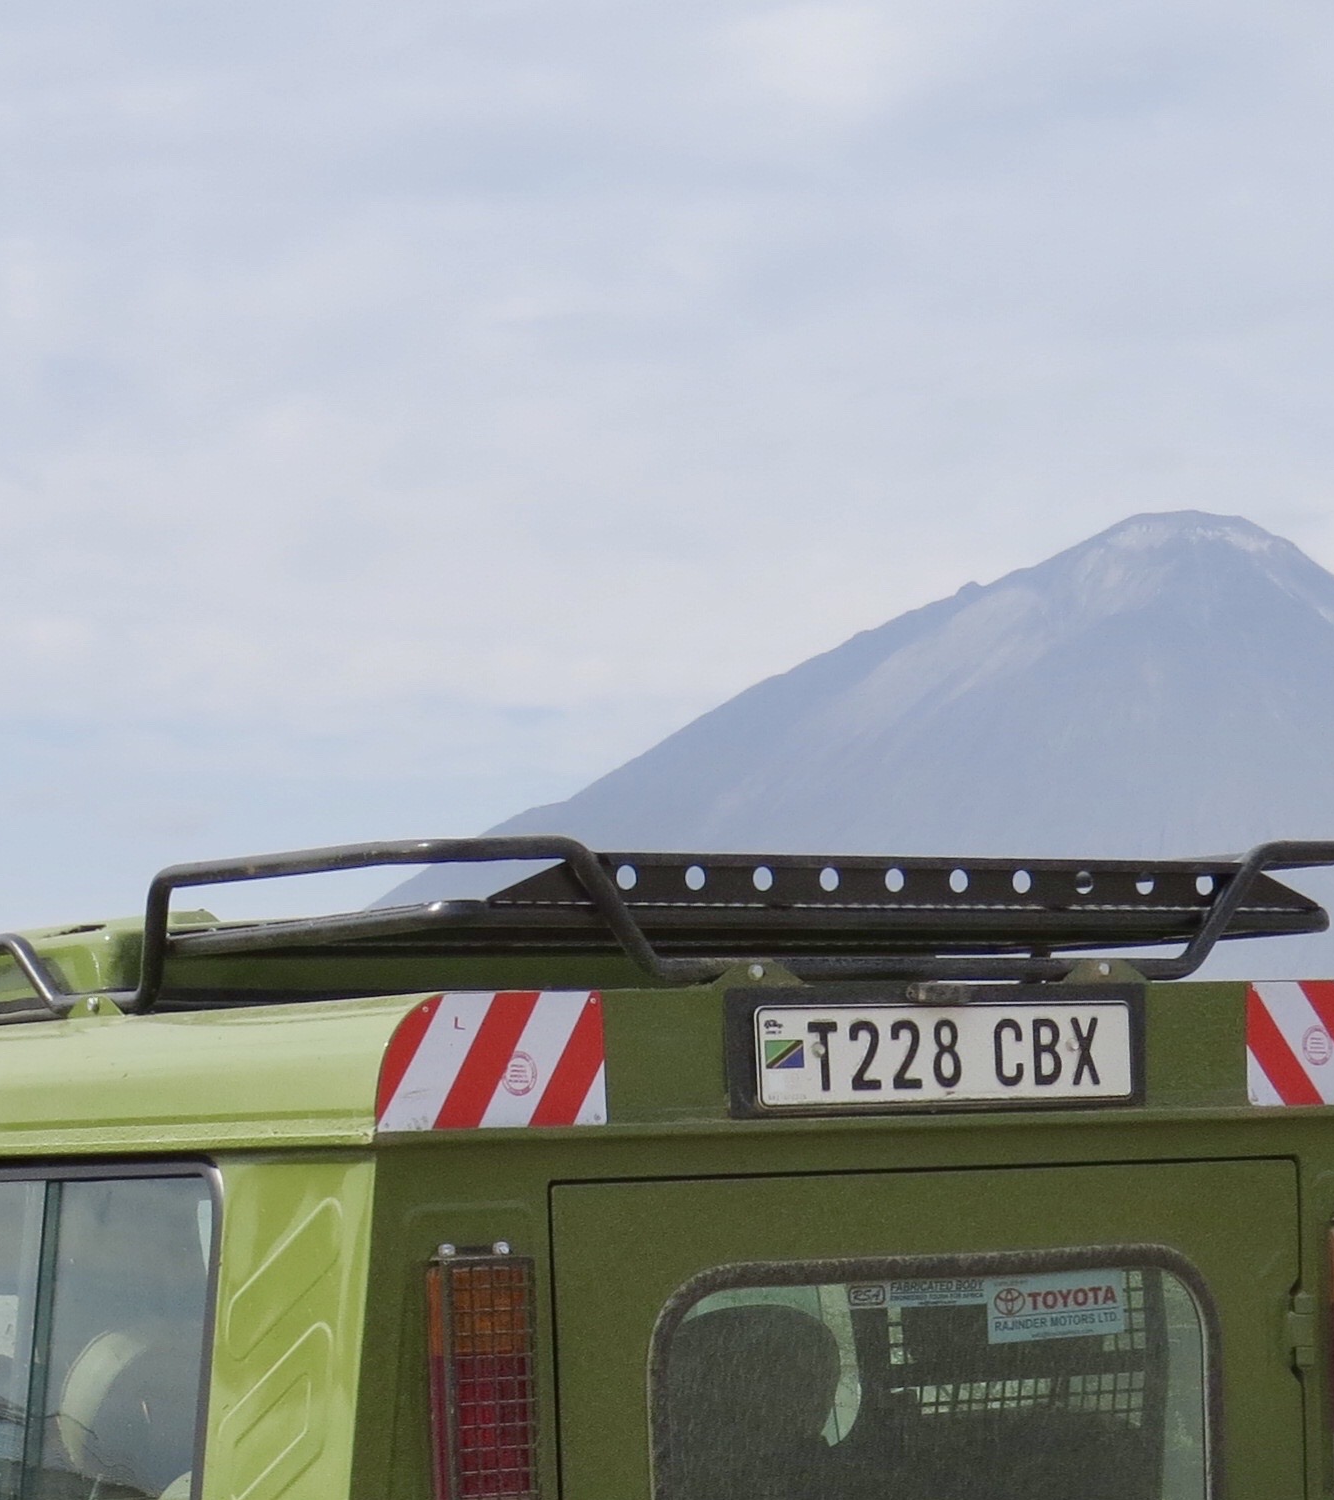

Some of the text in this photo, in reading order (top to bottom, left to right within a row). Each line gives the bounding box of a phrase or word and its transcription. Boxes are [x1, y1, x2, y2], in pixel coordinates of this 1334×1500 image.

[453, 1016, 466, 1030] L
[807, 1016, 1101, 1091] T228 CBX
[890, 1281, 954, 1292] FABRICATED
[955, 1279, 984, 1290] BODY
[1027, 1286, 1117, 1310] TOYOTA
[994, 1318, 1048, 1332] RAJINDER
[1050, 1313, 1095, 1327] MOTORS
